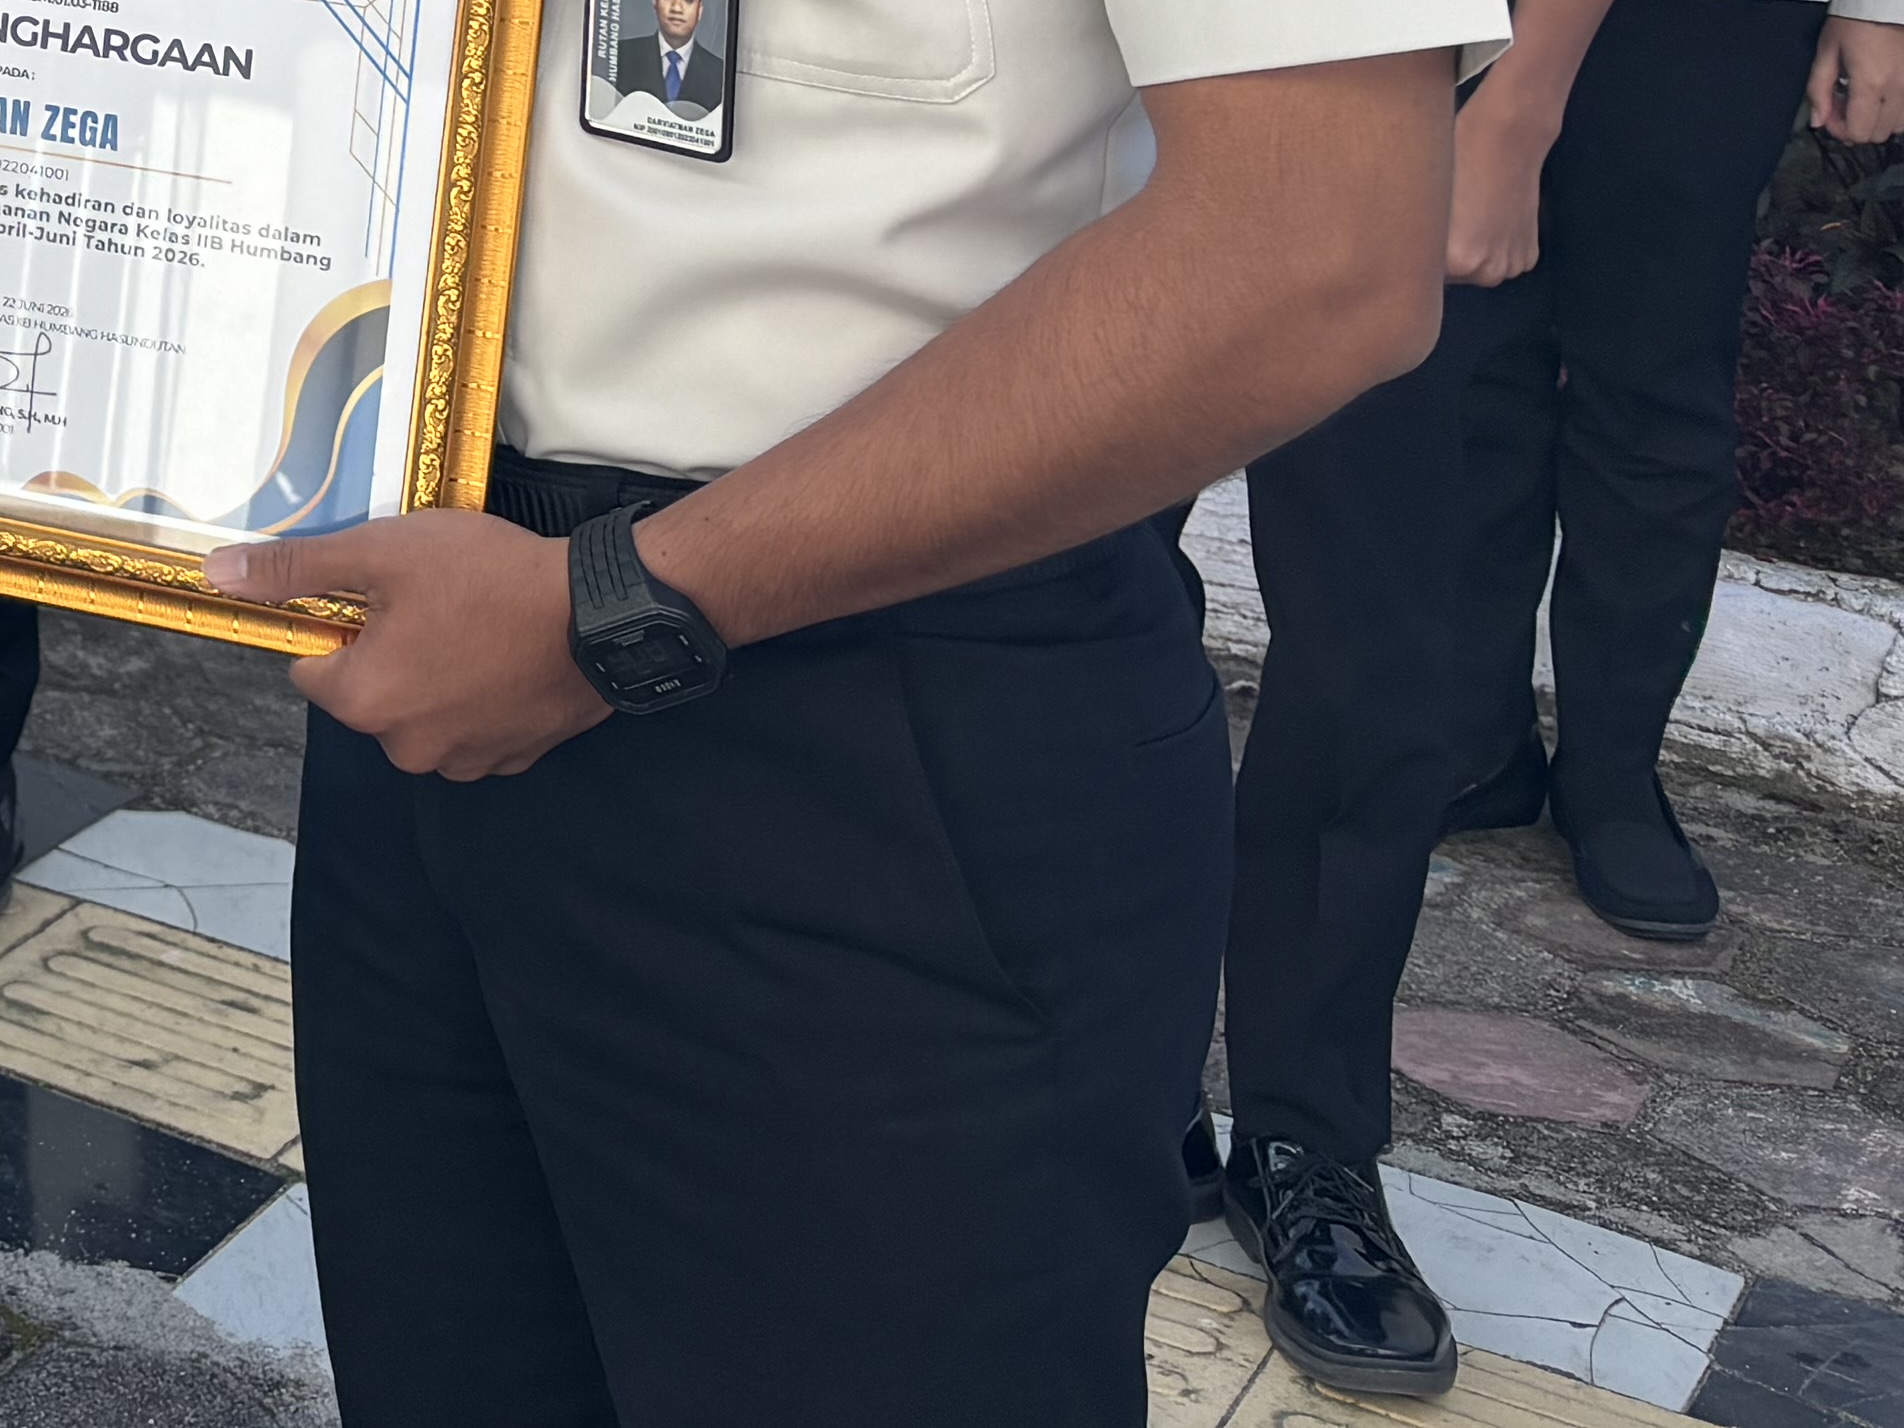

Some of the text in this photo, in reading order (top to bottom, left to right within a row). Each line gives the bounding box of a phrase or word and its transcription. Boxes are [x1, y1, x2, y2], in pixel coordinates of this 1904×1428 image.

[40, 103, 120, 152] ZEGA
[15, 183, 116, 214] kehadiran
[121, 201, 160, 221] dan
[167, 208, 251, 236] loyalitas
[257, 224, 322, 247] dalam
[57, 211, 129, 236] Negara
[136, 224, 191, 247] Kelas
[197, 232, 224, 250] IIB
[230, 238, 332, 271] Humbang
[83, 234, 145, 259] Tahun
[152, 247, 206, 269] 2026.
